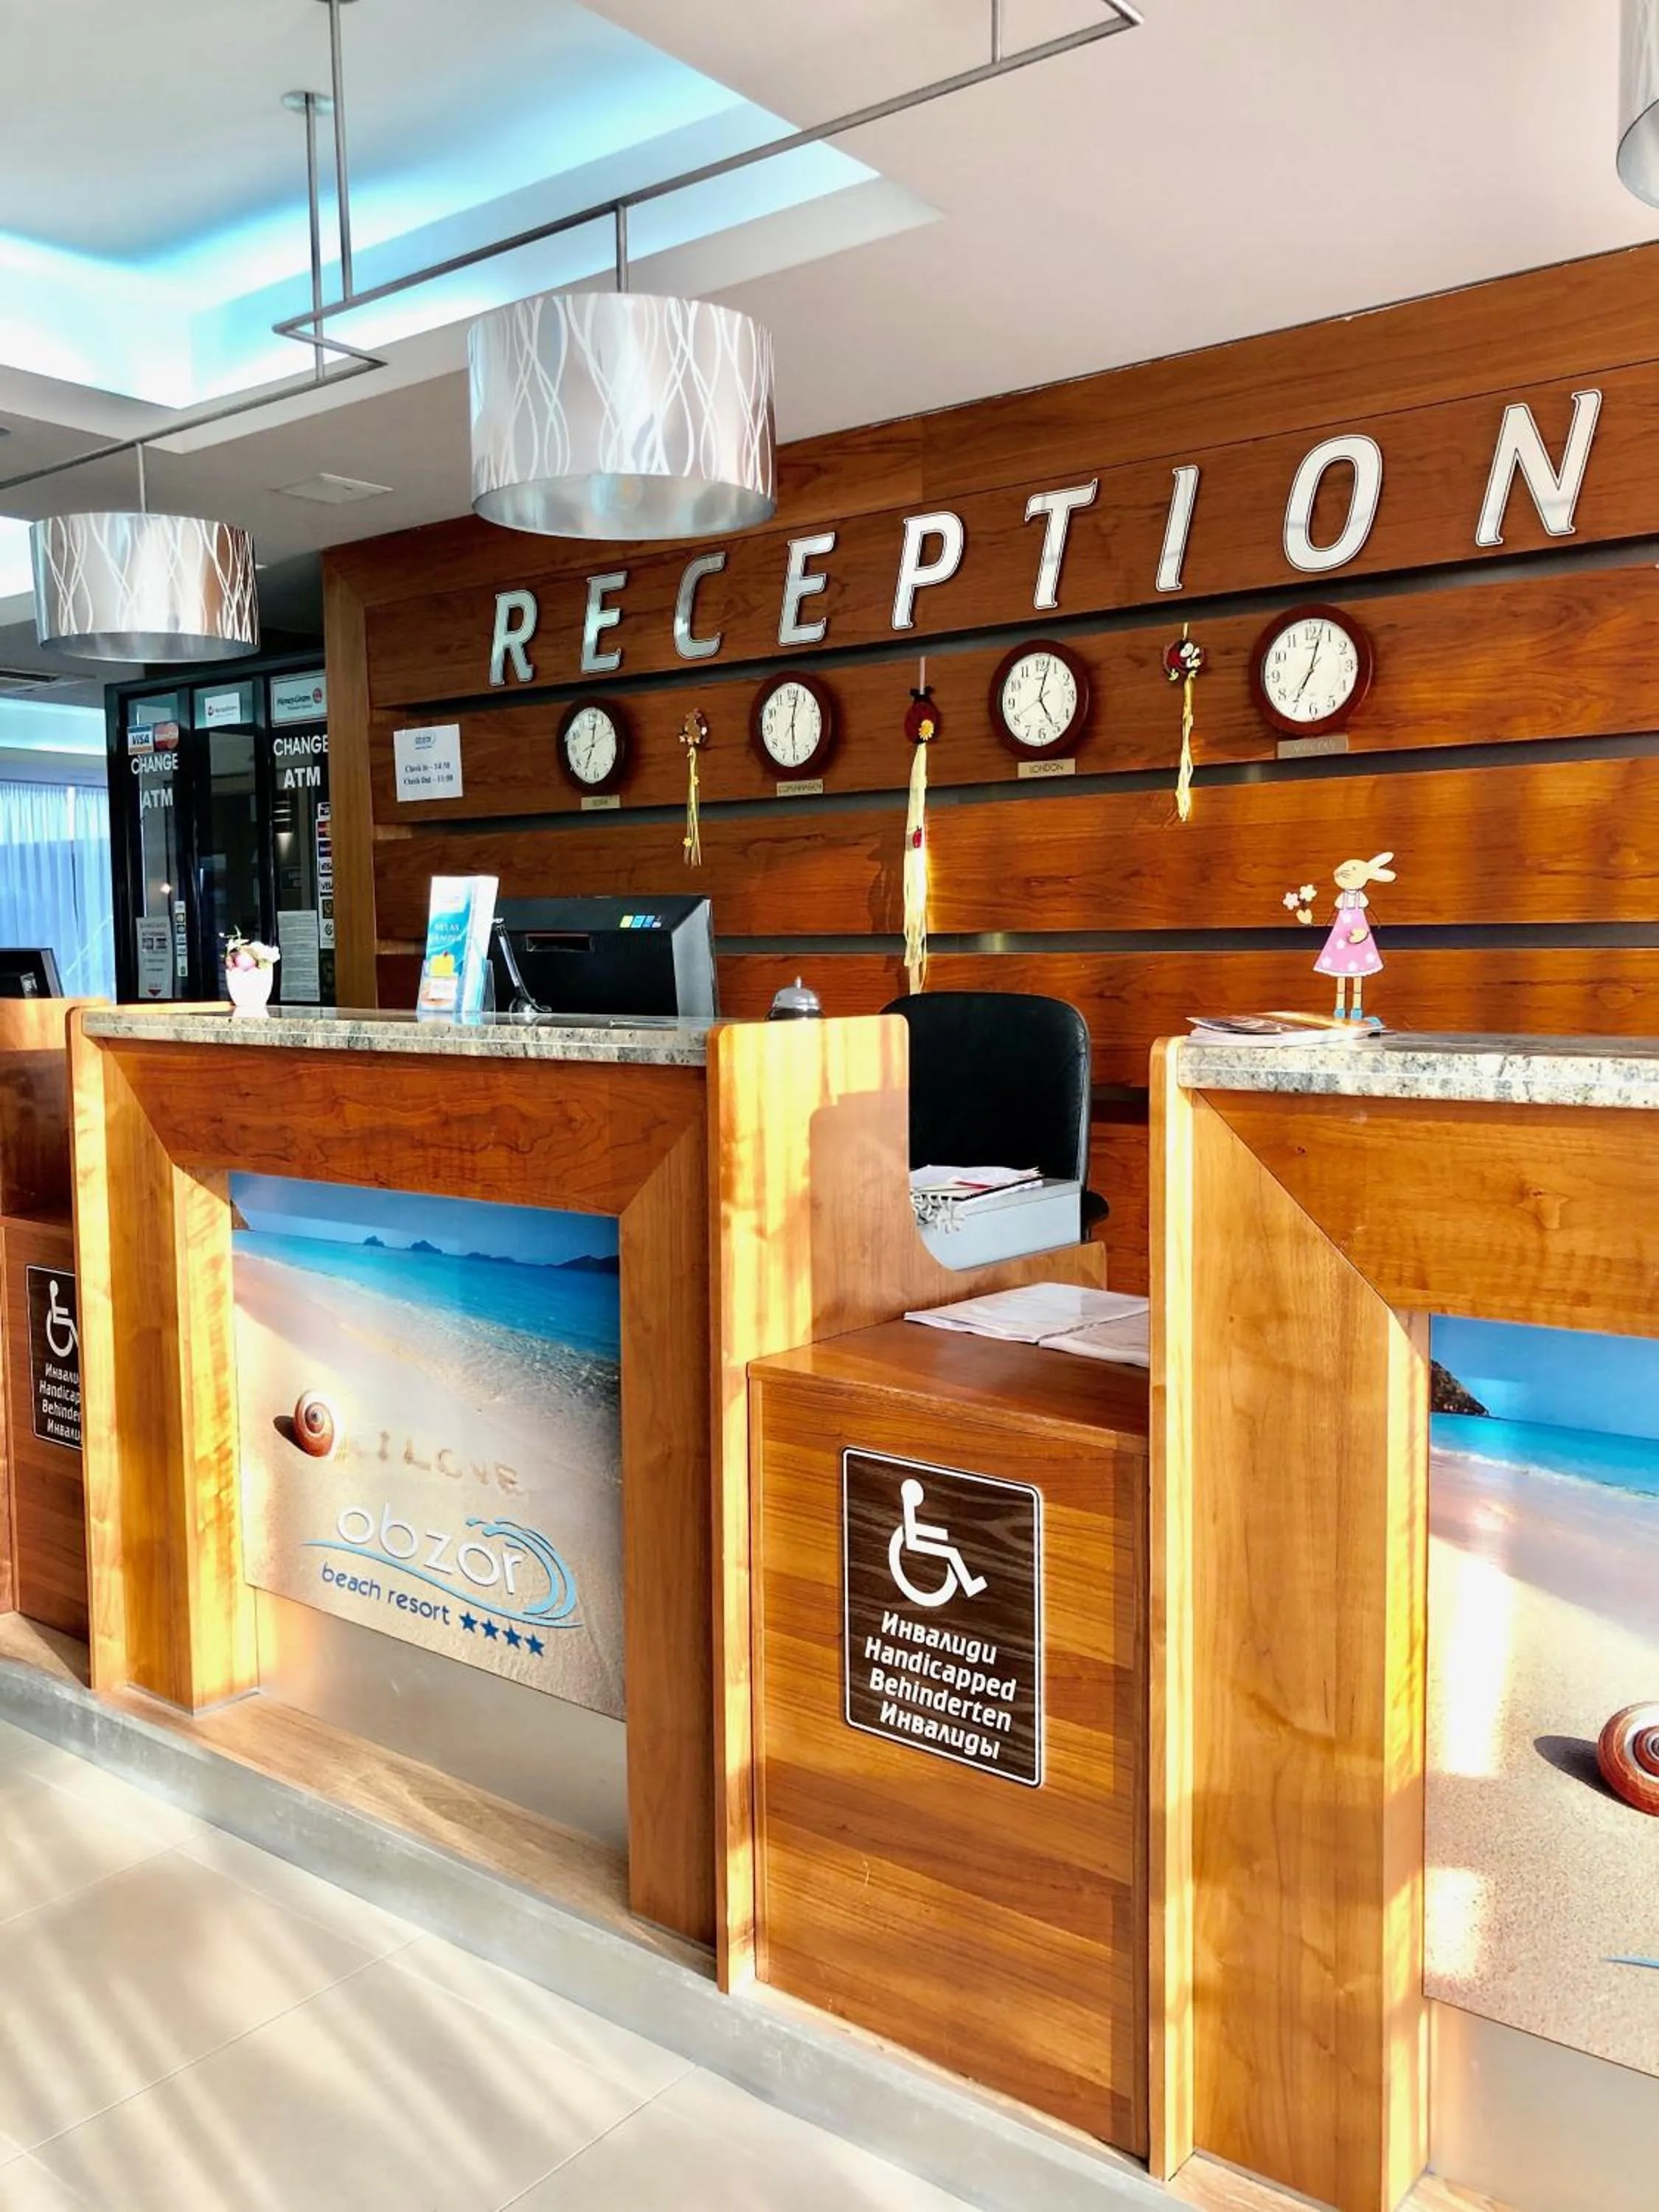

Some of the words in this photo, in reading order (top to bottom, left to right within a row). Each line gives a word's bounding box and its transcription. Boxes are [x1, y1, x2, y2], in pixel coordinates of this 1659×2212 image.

[490, 389, 1602, 686] RECEPTION
[1287, 633, 1297, 648] 11
[1304, 625, 1317, 641] 12
[1338, 641, 1348, 655] 2
[1275, 650, 1287, 664] 10
[1021, 665, 1029, 678] 11
[1344, 658, 1354, 673] 3
[1062, 673, 1070, 686] 2
[1271, 669, 1281, 684] 9
[1011, 680, 1021, 693] 10
[1278, 687, 1287, 700] 8
[1068, 689, 1075, 703] 3
[1326, 695, 1336, 709] 5
[1008, 698, 1015, 710] 9
[1309, 702, 1318, 716] 6
[1013, 714, 1020, 726] 8
[1053, 720, 1061, 734] 5
[766, 723, 773, 735] 9
[1024, 725, 1032, 737] 7
[1037, 728, 1046, 740] 6
[133, 734, 150, 745] VISA
[273, 734, 330, 756] CHANGE
[131, 752, 179, 774] CHANGE
[1029, 763, 1064, 773] LONDON
[283, 765, 321, 790] ATM
[142, 787, 174, 810] ATM
[45, 1362, 80, 1385] Инвали
[39, 1380, 80, 1405] Handicap
[46, 1418, 80, 1441] Инвали
[337, 1500, 524, 1595] obzor
[321, 1562, 382, 1601] beach
[387, 1588, 451, 1626] resort
[881, 1610, 997, 1665] Инвалиди
[864, 1636, 1017, 1702] Handicapped
[869, 1667, 1012, 1732] Behinderten
[880, 1700, 1001, 1760] Инвалиды
